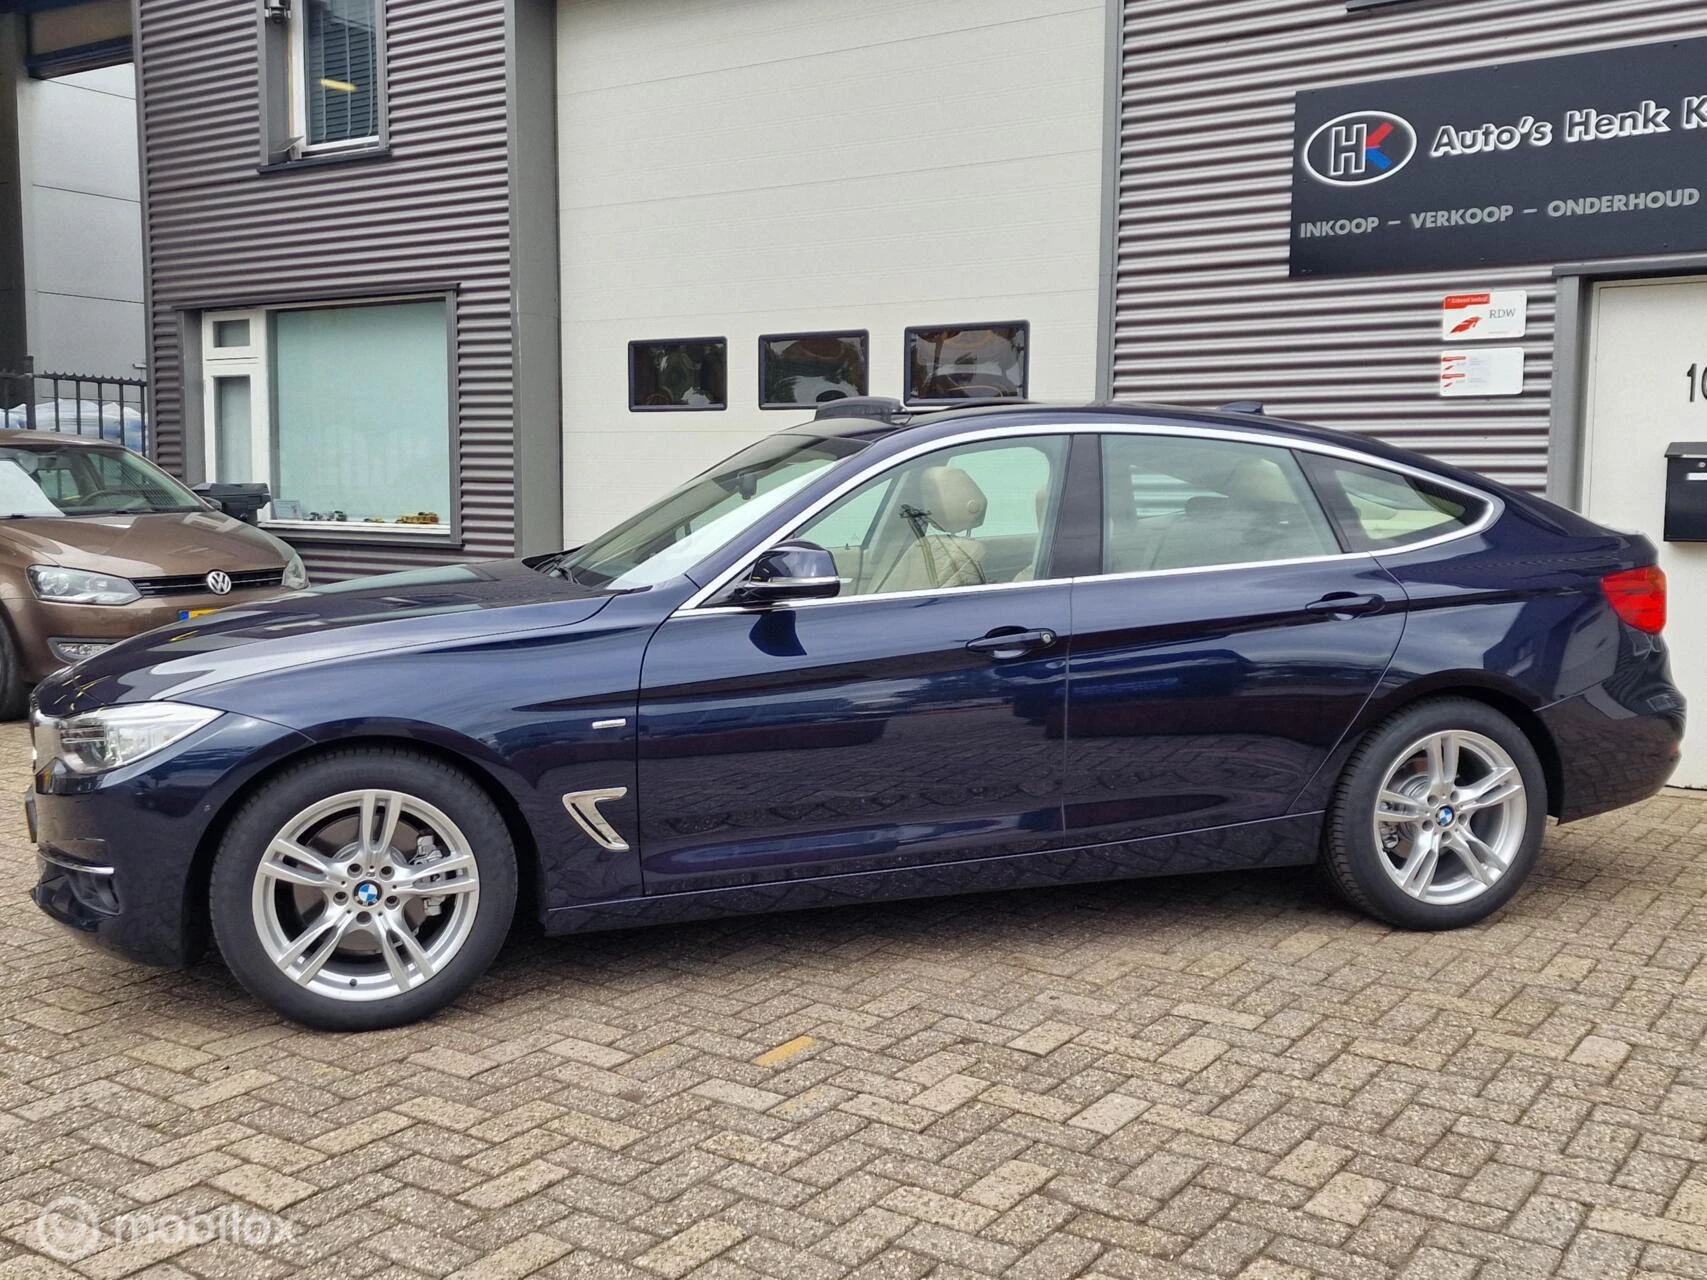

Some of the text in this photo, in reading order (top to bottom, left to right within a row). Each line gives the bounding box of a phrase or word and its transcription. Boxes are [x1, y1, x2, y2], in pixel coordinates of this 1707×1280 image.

[1430, 116, 1553, 158] Auto's
[1564, 101, 1671, 143] Henk
[1300, 216, 1379, 238] INKOOP
[1411, 205, 1513, 229] VERKOOP
[1547, 188, 1700, 218] ONDERHOUD
[1489, 308, 1516, 319] RDW
